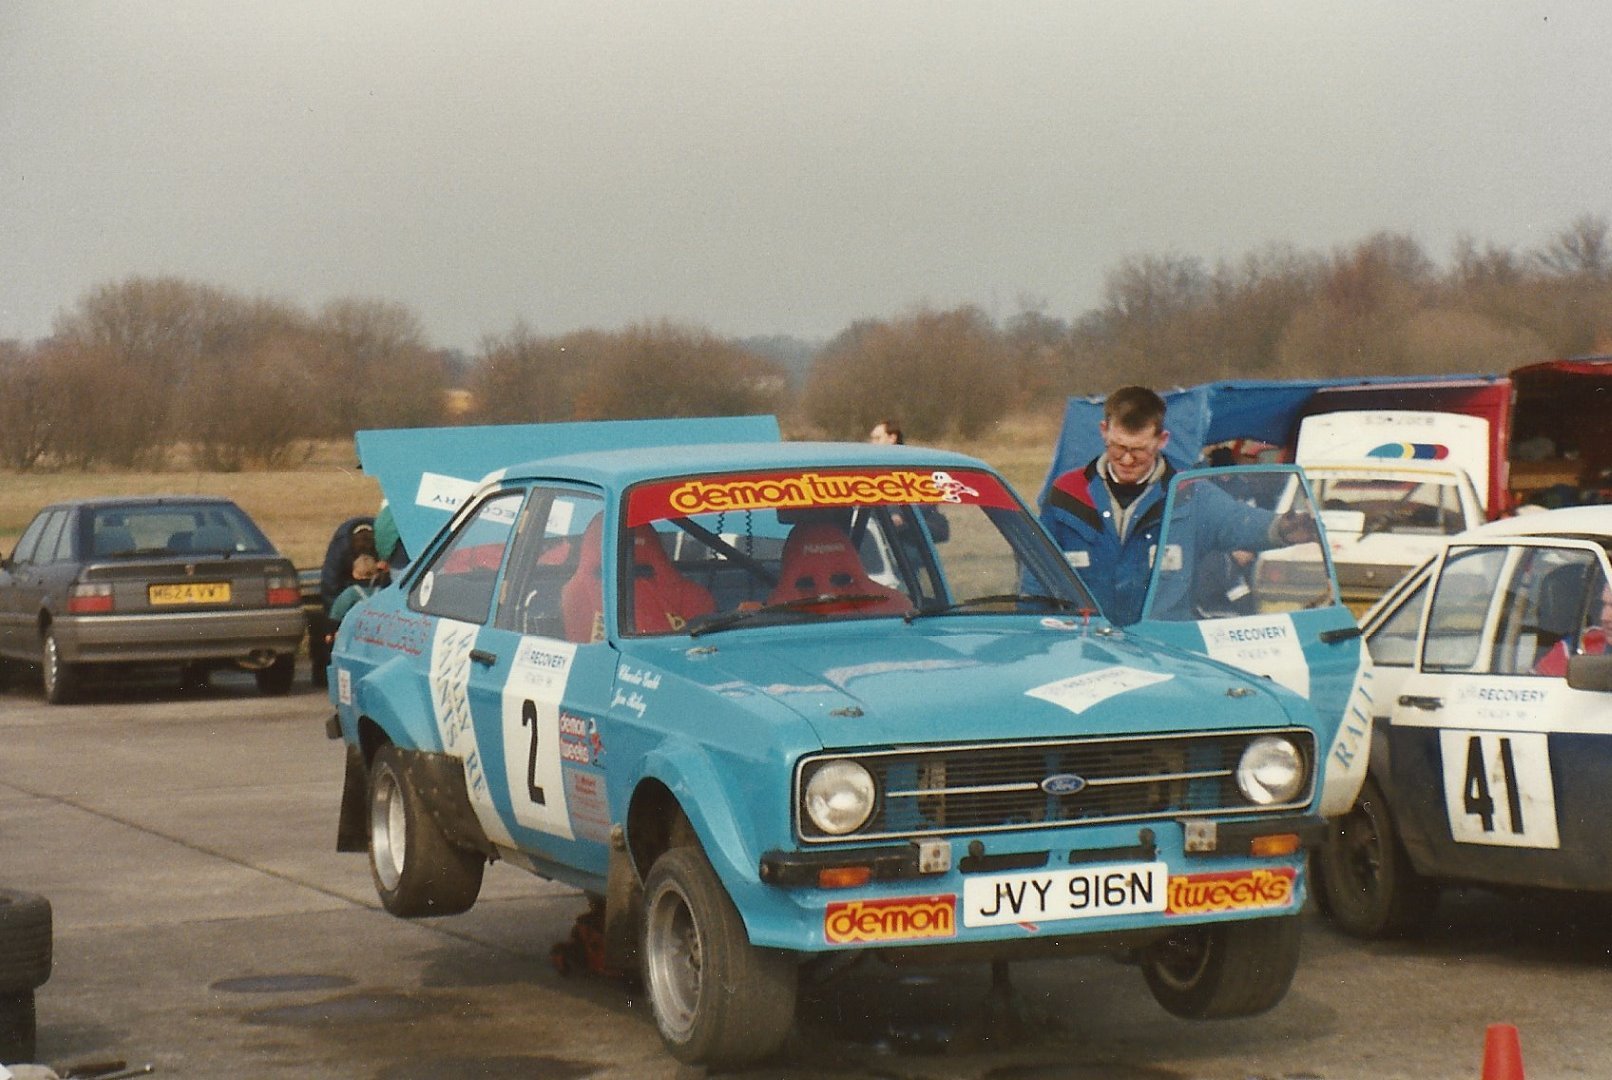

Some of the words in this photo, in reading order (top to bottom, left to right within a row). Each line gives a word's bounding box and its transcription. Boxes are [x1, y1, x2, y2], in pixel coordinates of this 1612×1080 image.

[671, 482, 807, 513] demon
[1228, 625, 1287, 643] RECOVERY
[530, 649, 567, 669] RECOVERY
[1479, 688, 1549, 702] RECOVERY
[522, 698, 546, 807] 2
[1463, 735, 1525, 835] 41
[979, 880, 1053, 917] JVY
[1068, 871, 1154, 911] 916N
[1168, 871, 1292, 914] tweeks
[826, 902, 955, 942] demon
